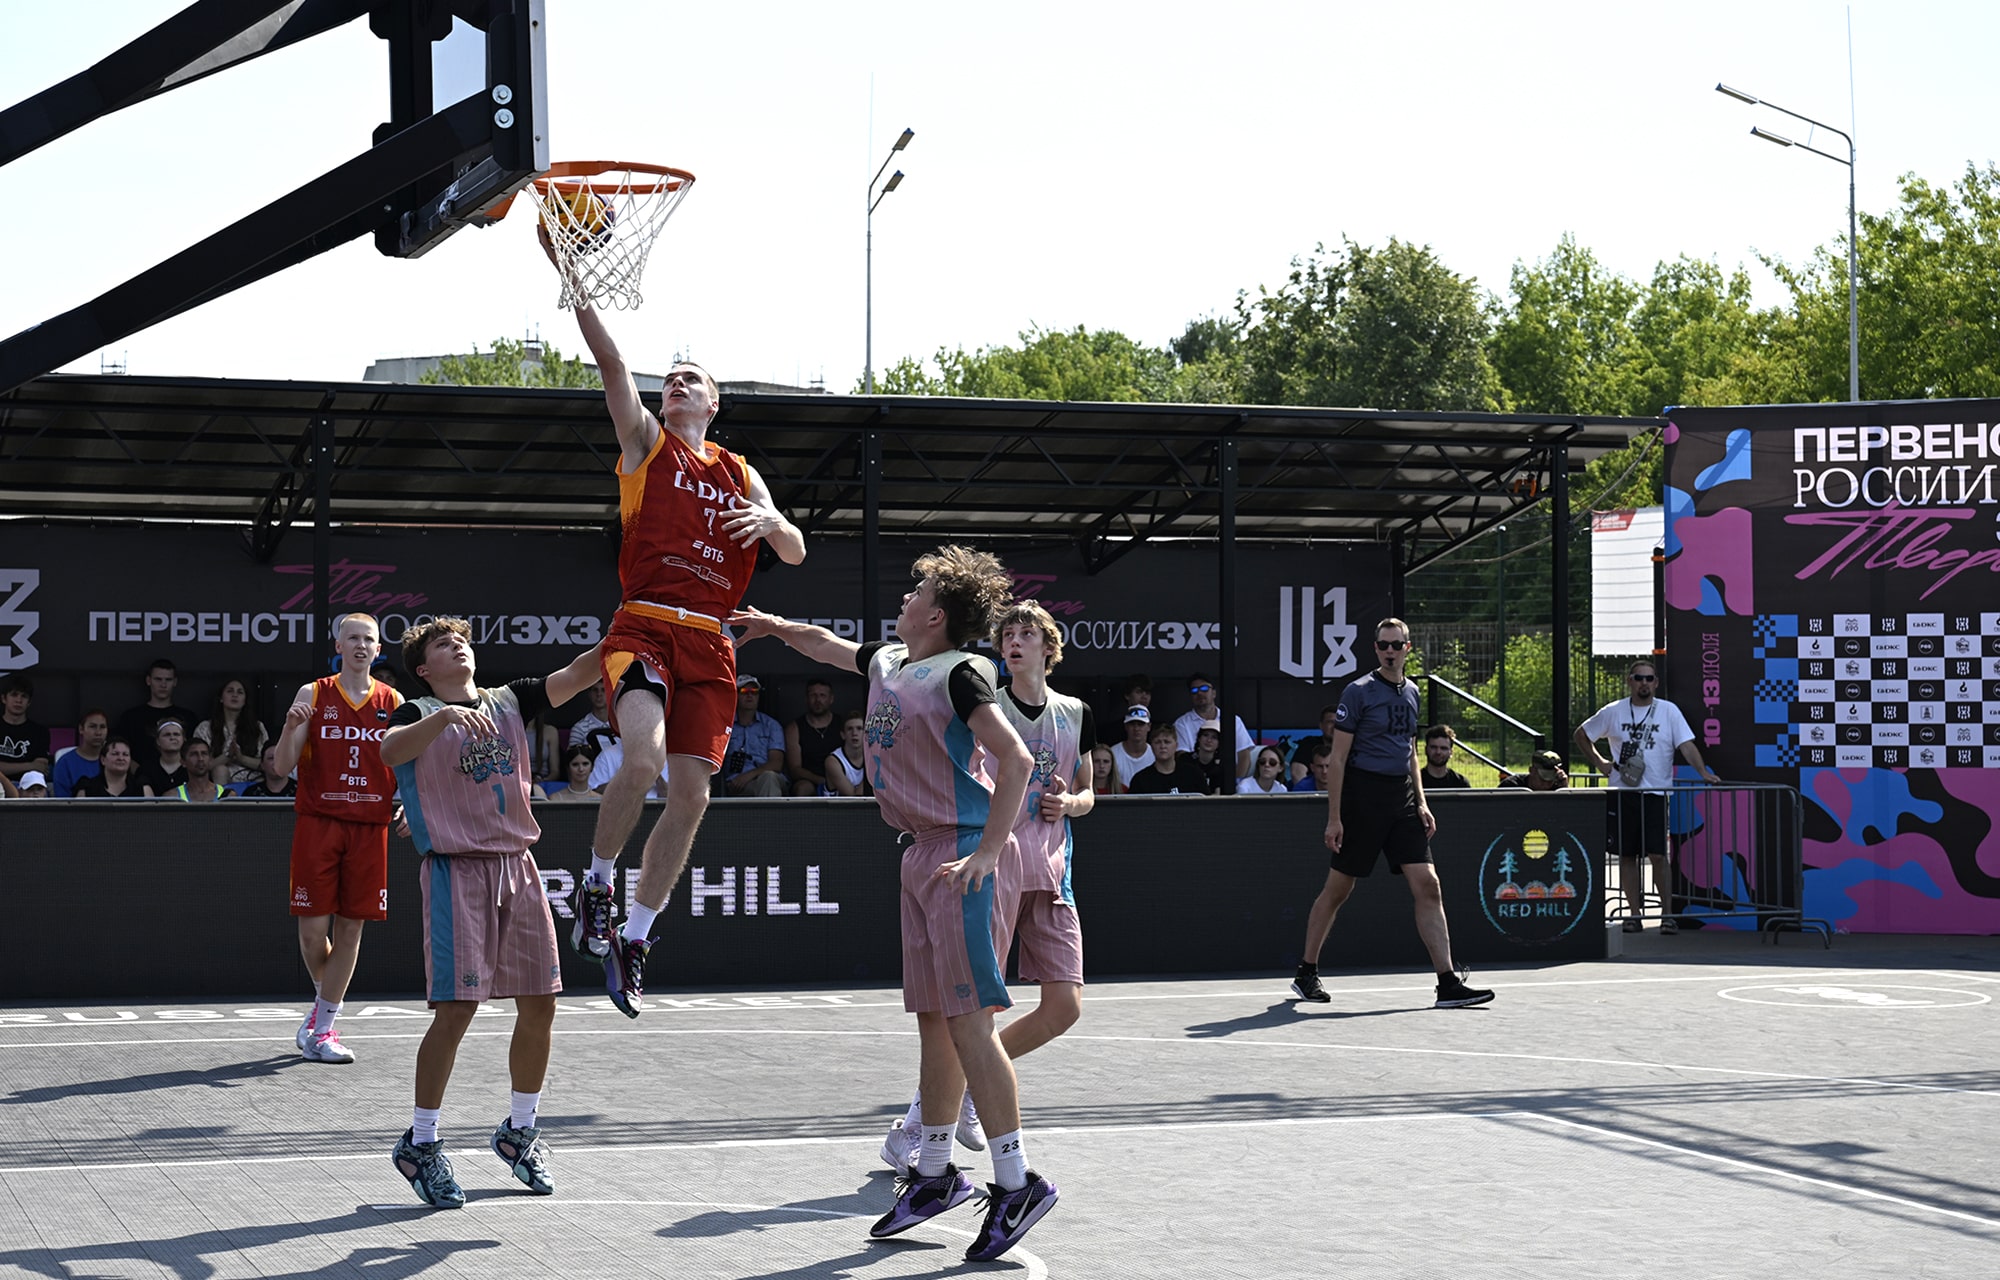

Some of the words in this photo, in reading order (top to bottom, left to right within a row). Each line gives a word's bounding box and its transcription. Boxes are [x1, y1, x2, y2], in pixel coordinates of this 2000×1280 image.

[1793, 422, 2000, 463] ПЕРВЕН
[1792, 464, 1999, 508] РОССИИ
[703, 507, 717, 536] 7
[702, 546, 725, 563] ВТБ
[89, 611, 343, 644] ПЕРВЕНСТ
[1702, 632, 1720, 679] ИЮЛЯ
[323, 712, 338, 720] 890
[348, 745, 360, 769] 3
[347, 775, 368, 787] ВТБ
[491, 784, 505, 815] 1
[378, 888, 388, 911] 3
[690, 865, 840, 917] HILL
[1498, 903, 1532, 918] RED
[1535, 902, 1572, 918] HILL
[928, 1132, 949, 1142] 23
[1001, 1139, 1020, 1154] 23
